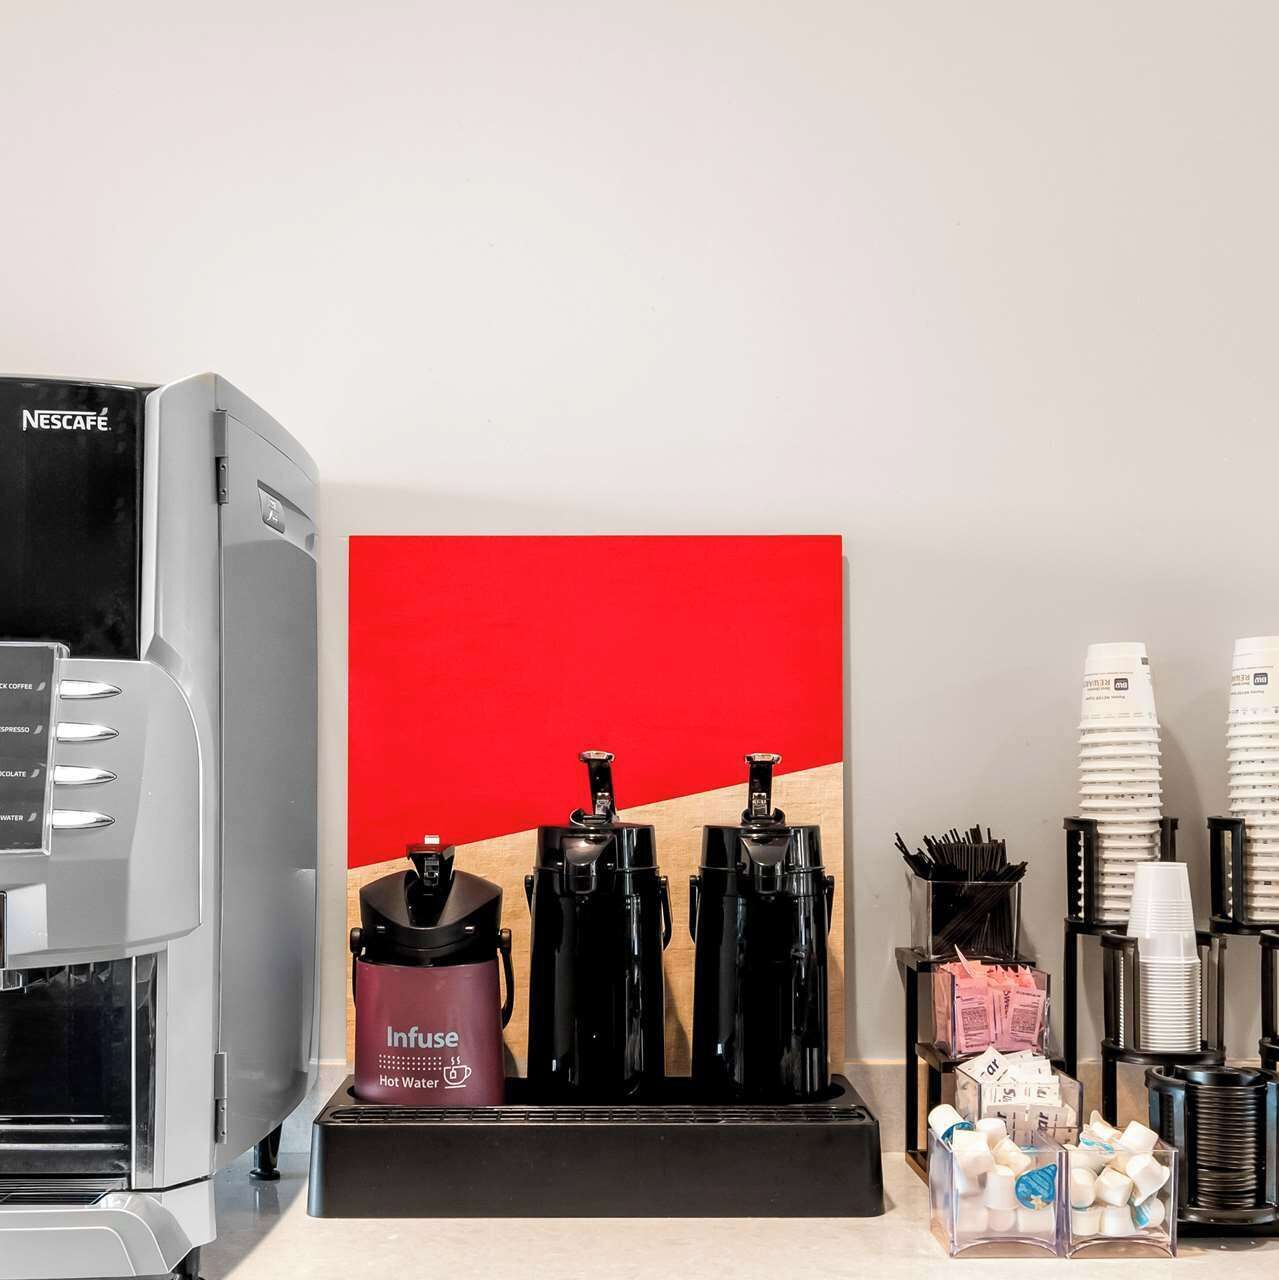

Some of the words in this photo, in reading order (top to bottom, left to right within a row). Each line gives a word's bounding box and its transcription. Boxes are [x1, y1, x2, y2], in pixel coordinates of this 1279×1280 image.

[22, 407, 109, 431] NESCAFÉ
[387, 1025, 459, 1048] Infuse
[379, 1074, 400, 1088] Hot
[401, 1076, 440, 1088] Water
